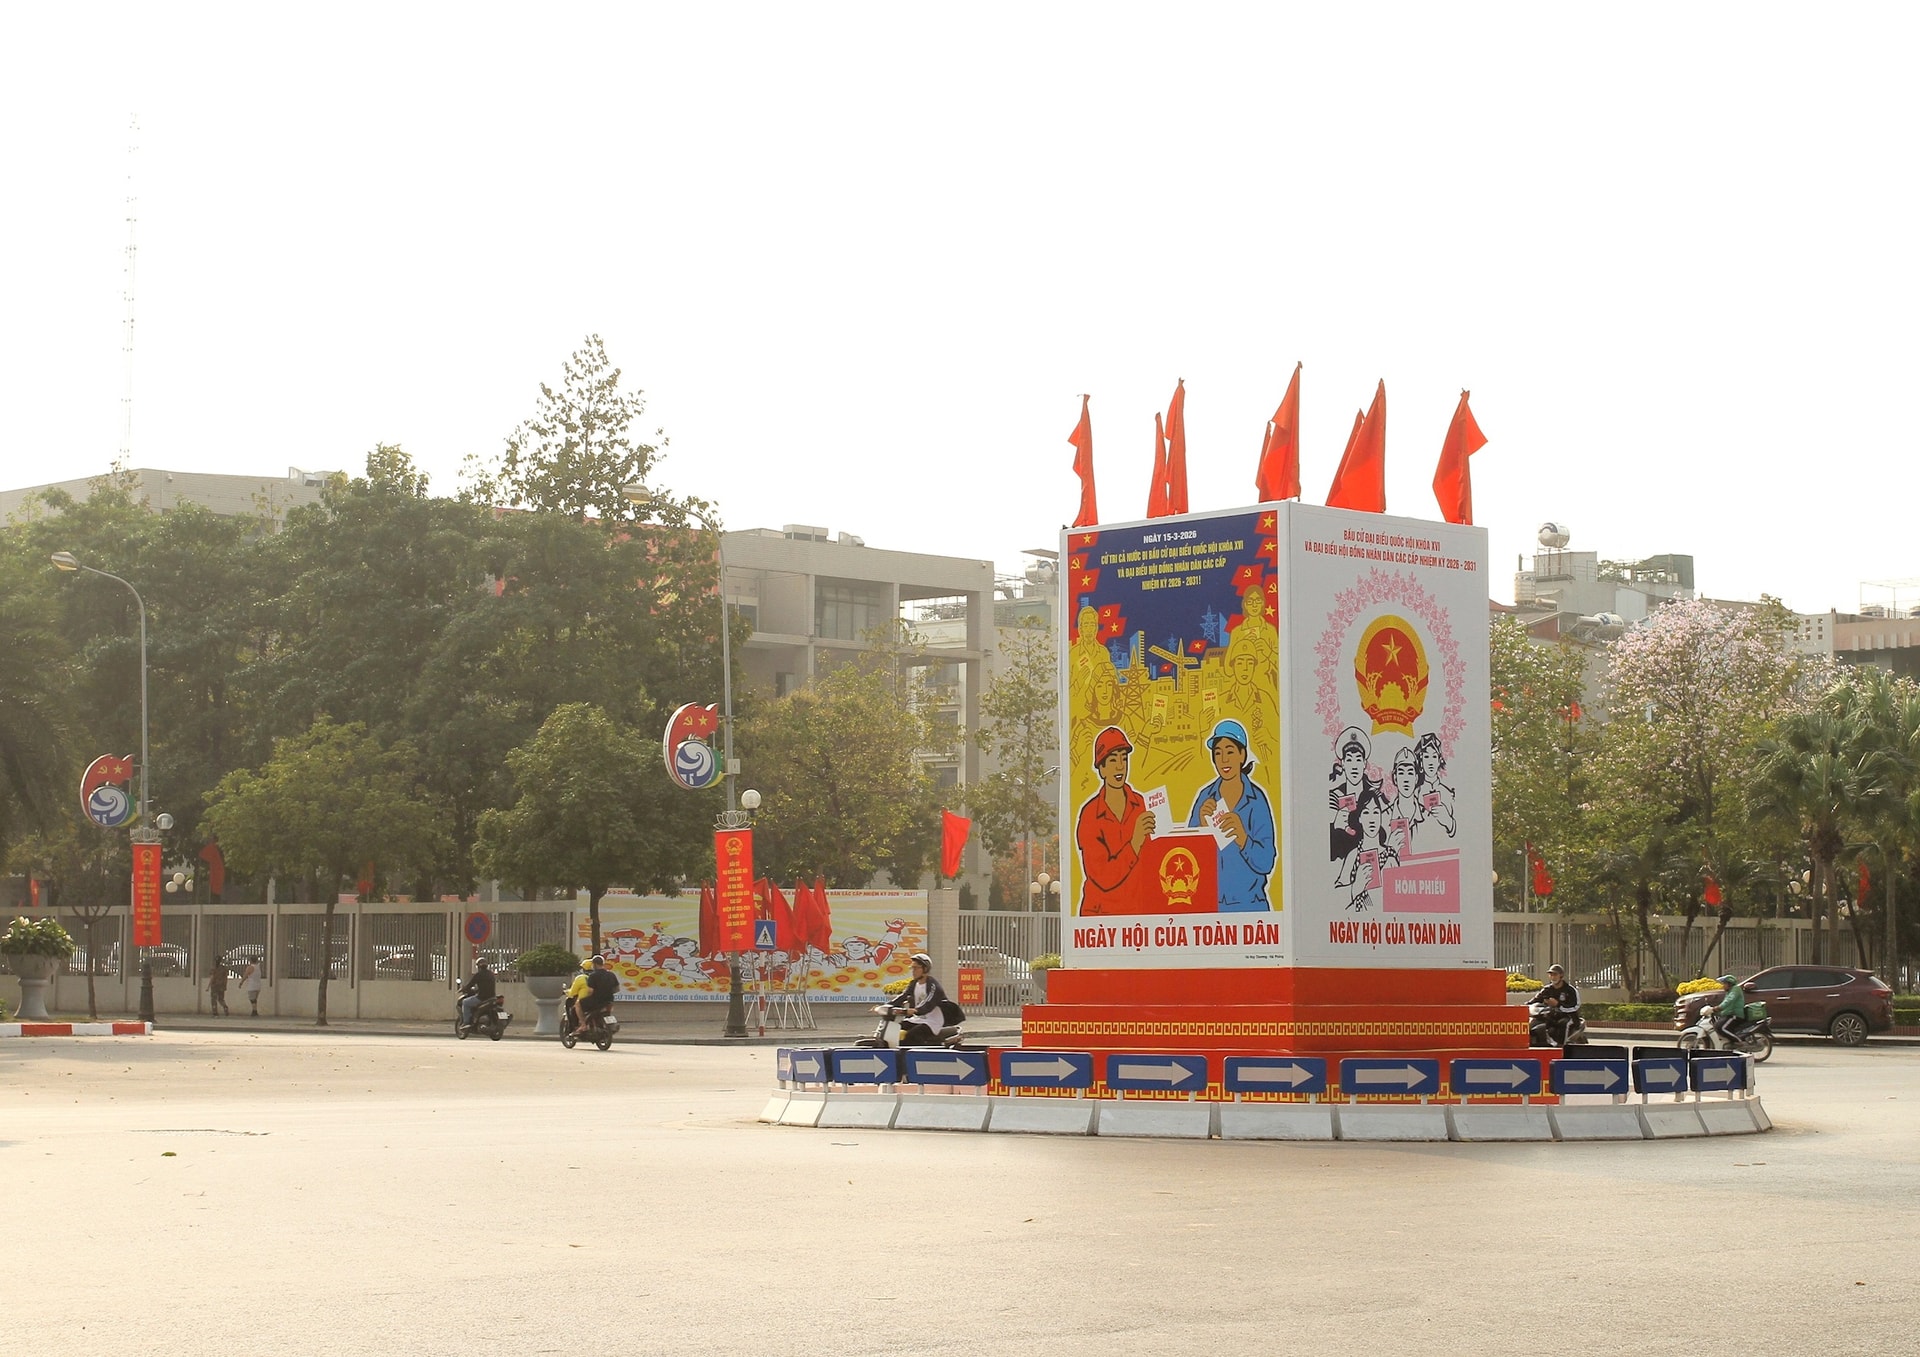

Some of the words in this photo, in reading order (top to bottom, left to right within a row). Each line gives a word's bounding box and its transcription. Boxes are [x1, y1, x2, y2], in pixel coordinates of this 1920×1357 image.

[1143, 532, 1161, 544] NGÀY
[1163, 530, 1197, 542] 15-3-2026
[1446, 559, 1459, 570] 2026
[1464, 561, 1476, 571] 2031
[1395, 876, 1417, 894] HÒM
[1419, 876, 1446, 895] PHIẾU
[1074, 924, 1117, 948] NGÀY
[1122, 923, 1149, 951] HỘI
[1154, 918, 1188, 947] CỦA
[1192, 921, 1238, 946] TOÀN
[1243, 920, 1279, 945] DÂN
[1330, 918, 1359, 943] NGÀY
[1363, 918, 1382, 950] HỘI
[1386, 917, 1406, 944] CỦA
[1408, 918, 1436, 944] TOÀN
[1440, 919, 1461, 945] DÂN
[972, 974, 981, 982] VỰC
